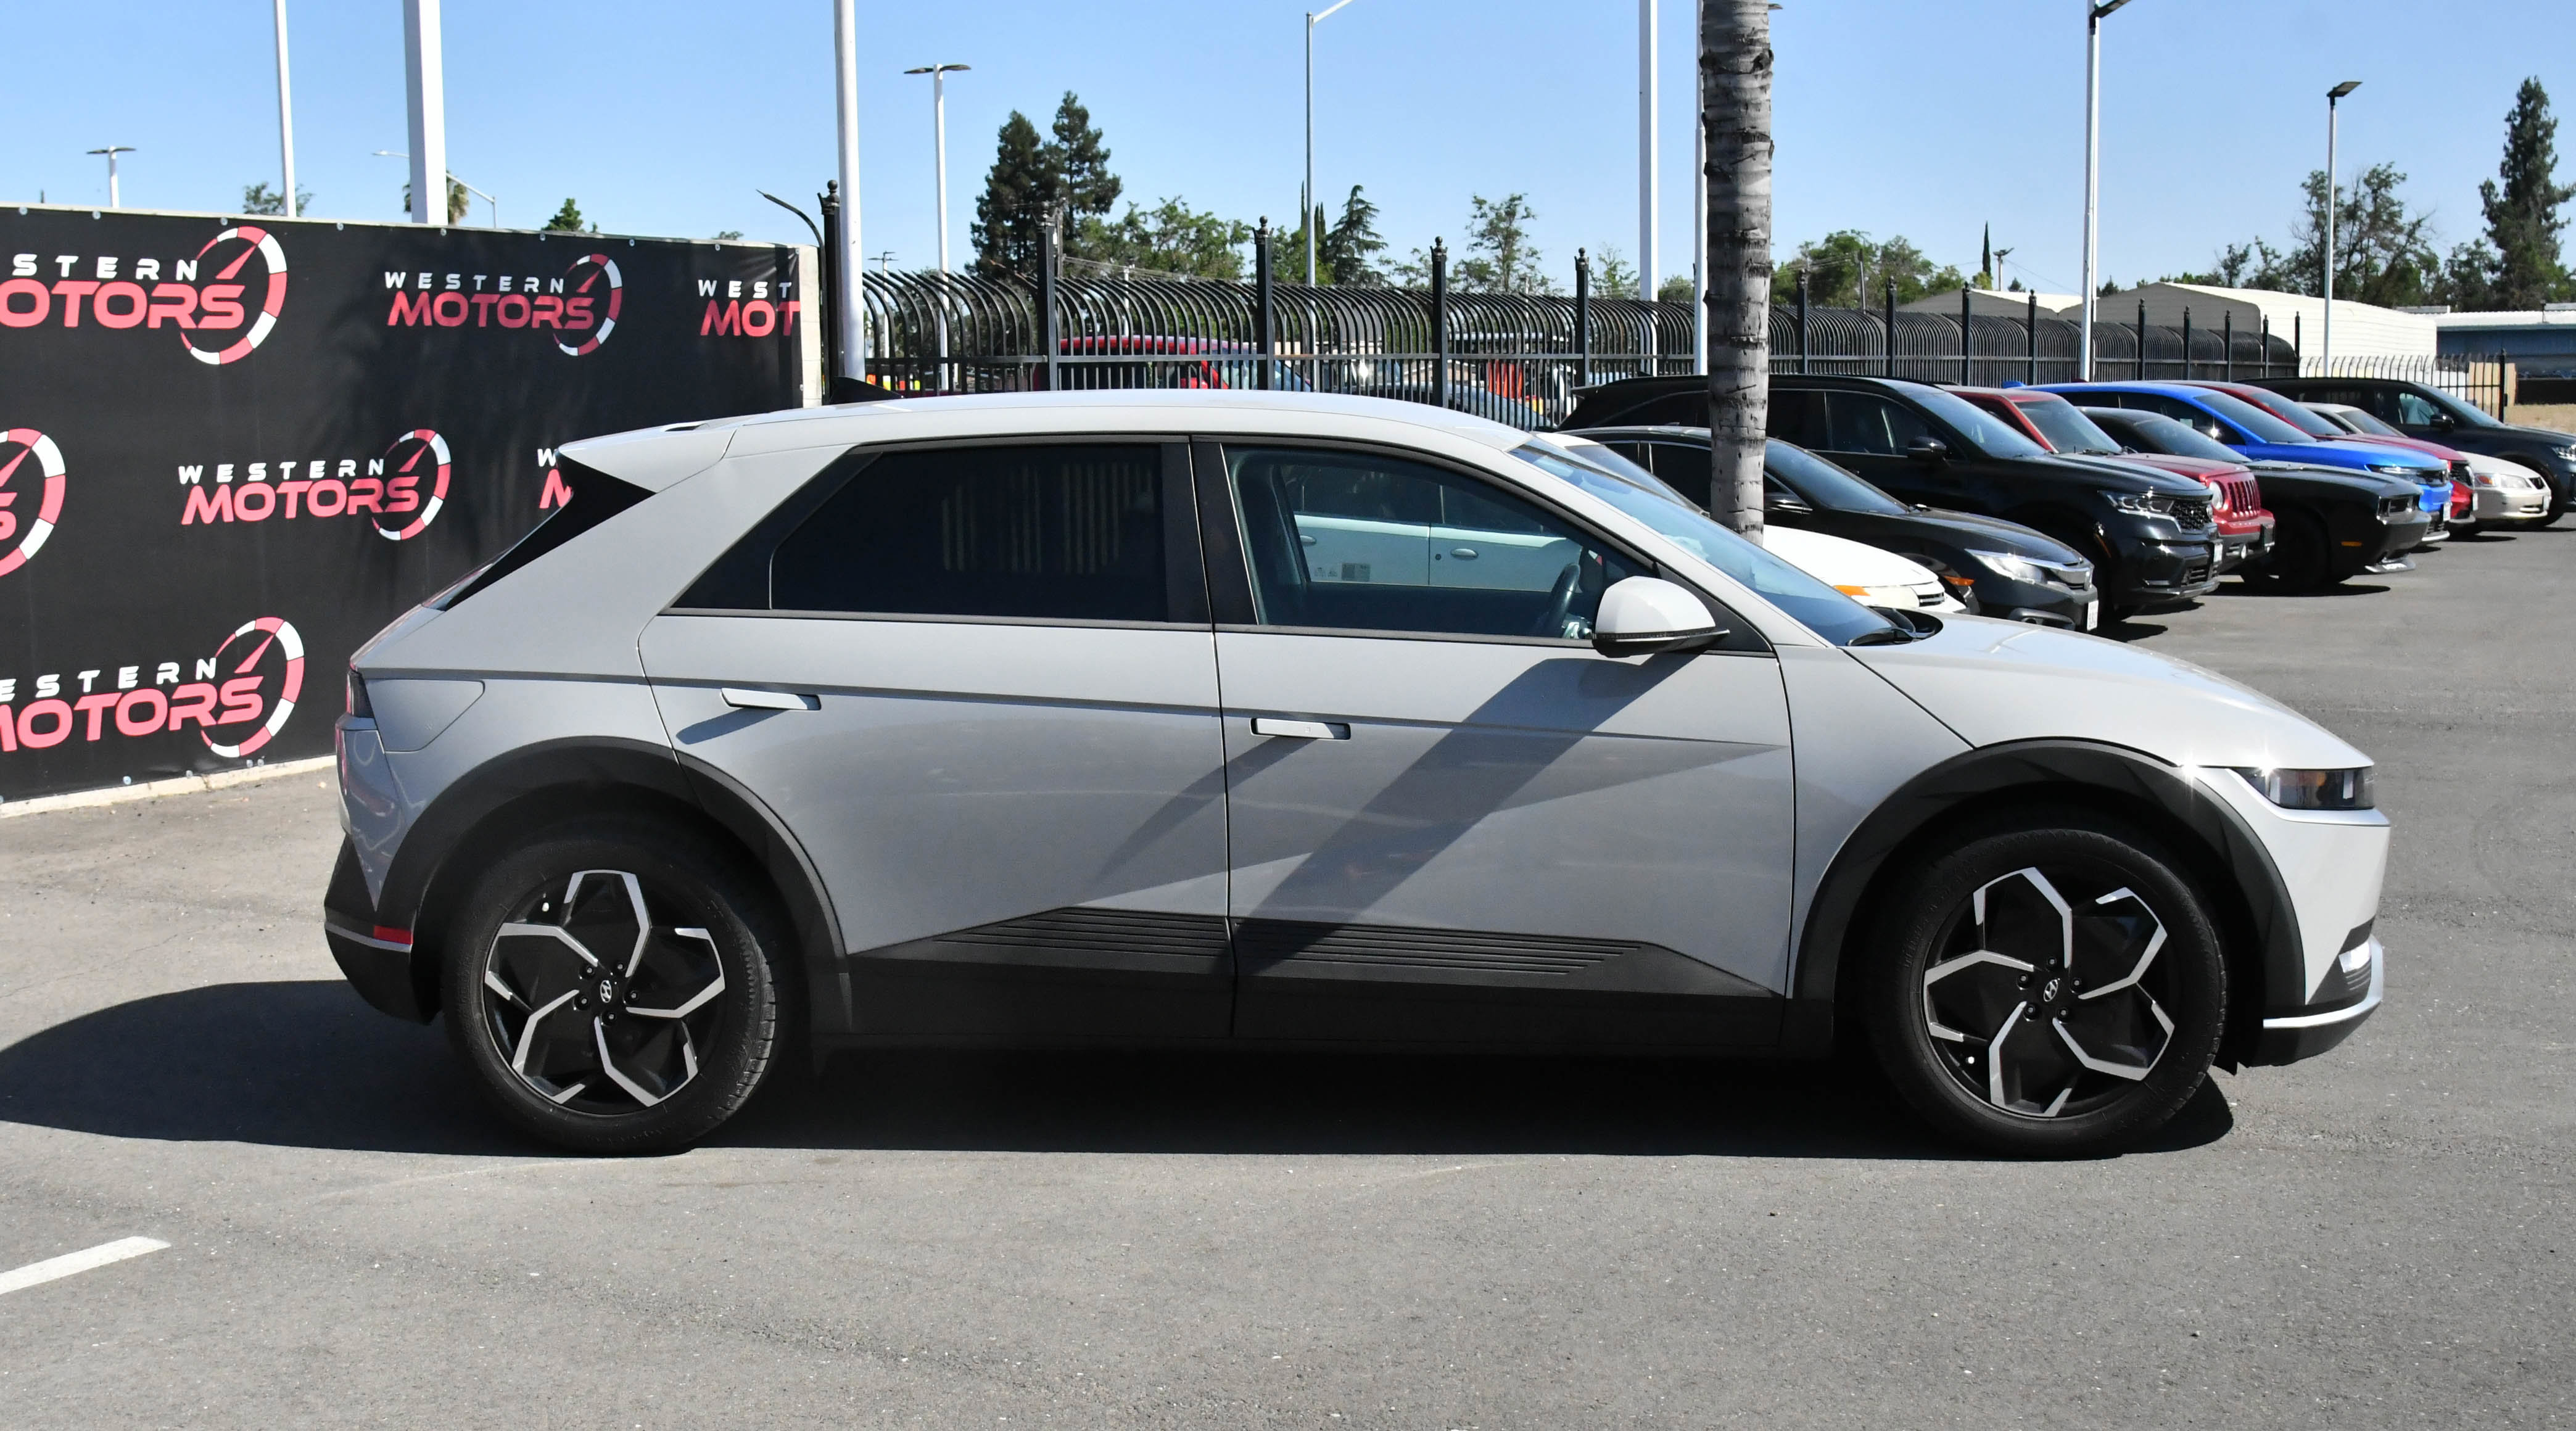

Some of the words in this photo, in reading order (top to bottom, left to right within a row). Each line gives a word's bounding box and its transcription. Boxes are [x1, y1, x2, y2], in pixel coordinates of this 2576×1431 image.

[12, 254, 198, 281] STERN
[384, 271, 564, 294] WESTERN
[698, 279, 792, 299] WEST
[387, 291, 594, 329] MOTORS
[700, 299, 801, 337] MOT
[178, 458, 384, 485] WESTERN
[180, 476, 419, 526] MOTORS
[0, 675, 264, 753] OTORS
